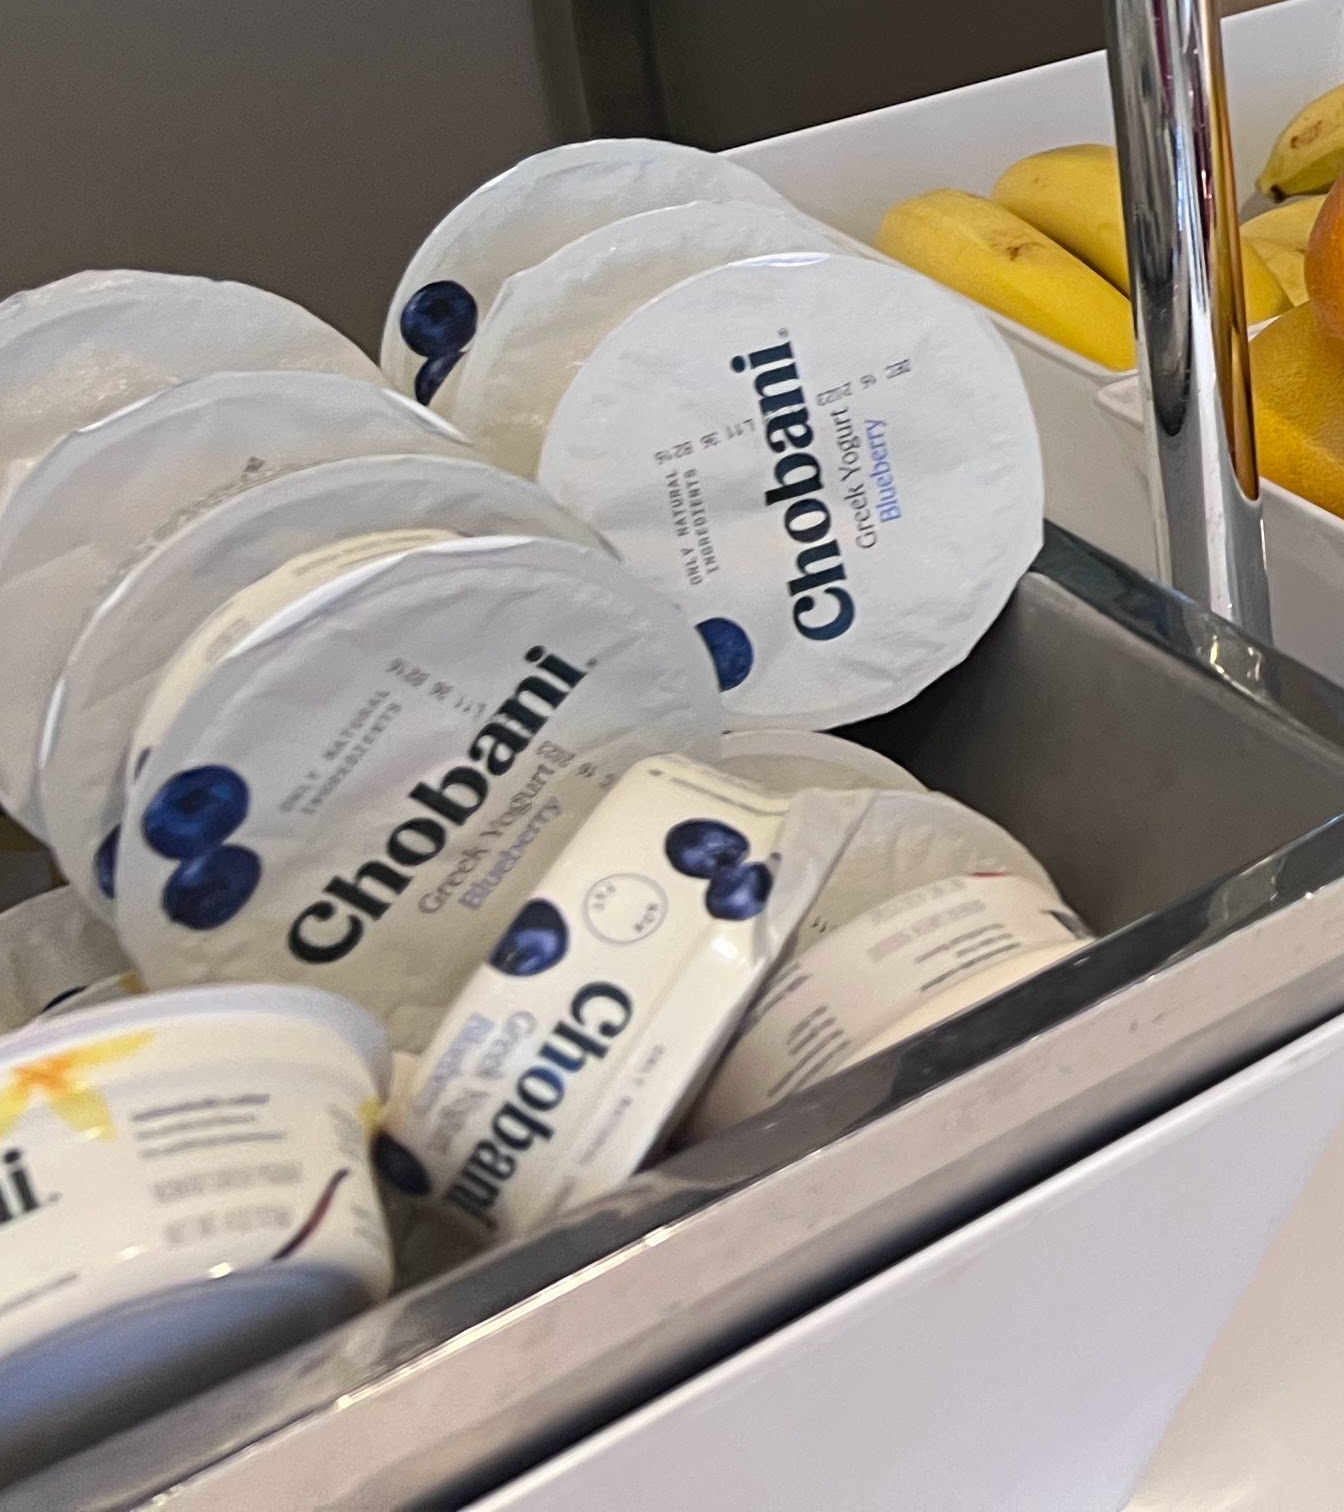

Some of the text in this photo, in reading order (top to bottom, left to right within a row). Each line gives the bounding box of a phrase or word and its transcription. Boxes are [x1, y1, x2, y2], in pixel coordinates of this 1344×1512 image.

[665, 469, 703, 585] ONLY NATURAL
[730, 341, 855, 641] Chobani
[831, 408, 878, 549] Greek Yogurt
[865, 419, 902, 523] Blueberry
[287, 645, 588, 965] Chobani
